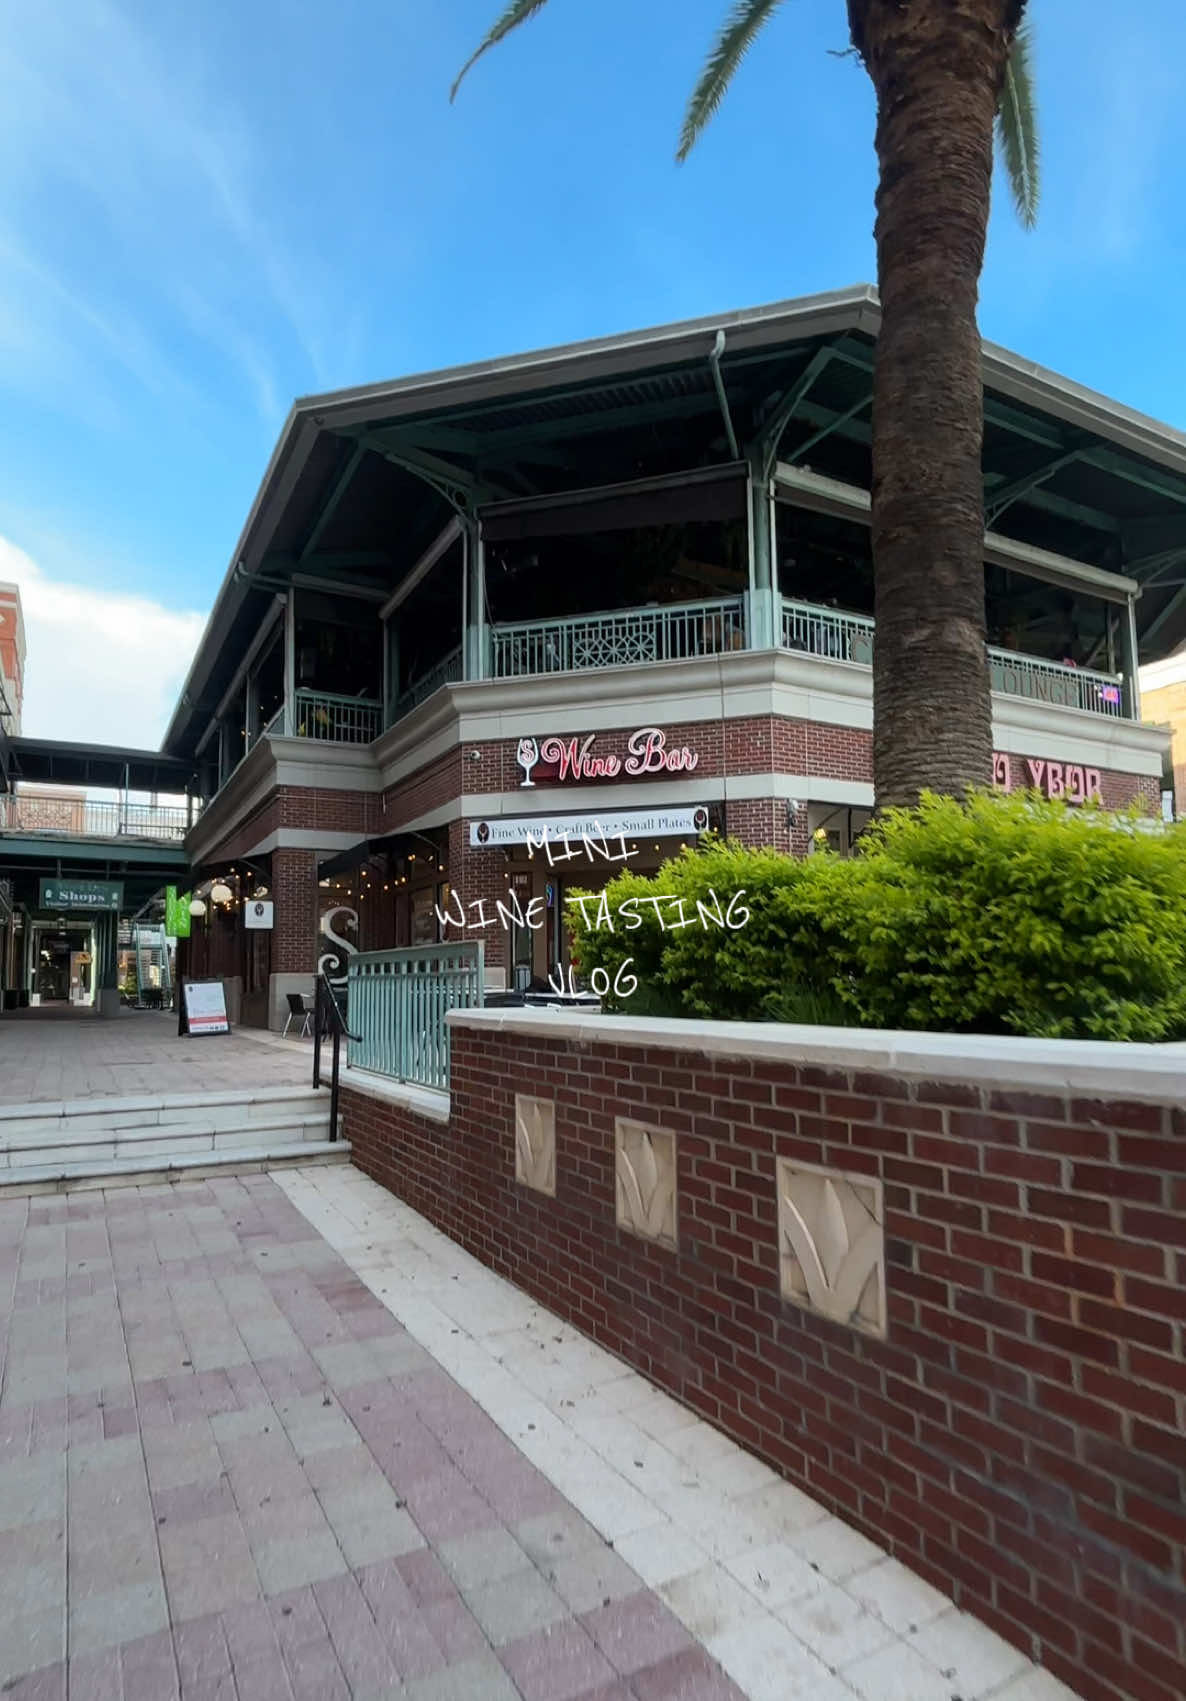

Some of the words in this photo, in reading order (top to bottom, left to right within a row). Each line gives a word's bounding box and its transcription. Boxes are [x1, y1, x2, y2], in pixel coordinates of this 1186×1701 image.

[1002, 668, 1079, 707] OUNGE
[540, 734, 622, 781] Wine
[625, 728, 699, 776] Bar
[1026, 759, 1104, 805] YBOR
[491, 825, 514, 839] Fine
[556, 822, 582, 834] Craft
[621, 819, 654, 831] Small
[658, 817, 693, 829] Plates
[58, 890, 105, 903] Shops
